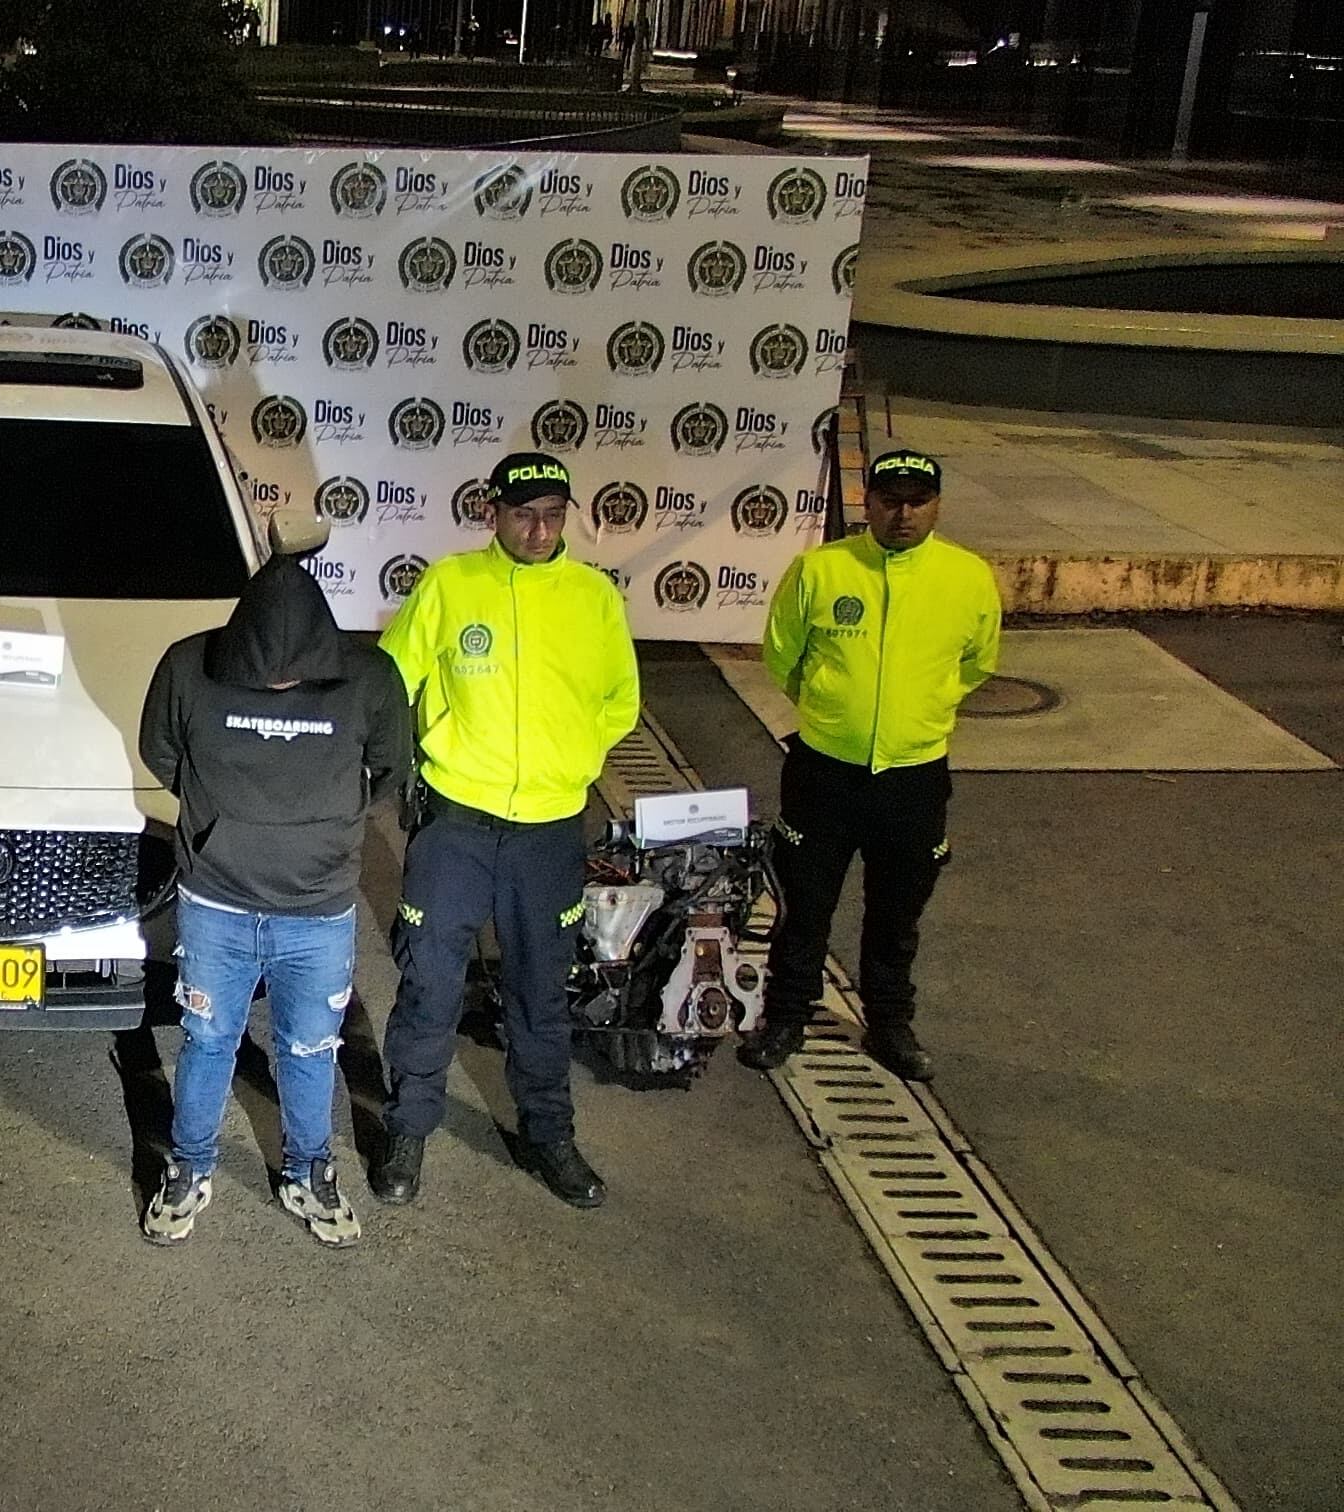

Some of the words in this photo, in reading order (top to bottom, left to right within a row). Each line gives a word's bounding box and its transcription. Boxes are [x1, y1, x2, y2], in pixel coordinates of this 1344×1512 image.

[18, 176, 24, 190] y
[115, 164, 154, 189] Dios
[160, 178, 166, 192] y
[255, 166, 294, 191] Dios
[300, 180, 306, 194] y
[540, 169, 580, 194] Dios
[586, 184, 592, 198] y
[688, 171, 728, 196] Dios
[734, 186, 742, 200] y
[115, 190, 166, 212] Patria
[255, 192, 306, 214] Patria
[539, 195, 591, 218] Patria
[687, 197, 740, 219] Patria
[44, 236, 83, 261] Dios
[88, 250, 94, 264] y
[184, 238, 223, 263] Dios
[228, 252, 234, 266] y
[464, 242, 503, 267] Dios
[510, 256, 516, 270] y
[611, 244, 651, 269] Dios
[656, 258, 664, 272] y
[754, 246, 794, 271] Dios
[800, 260, 808, 274] y
[44, 261, 94, 283] Patria
[184, 264, 234, 285] Patria
[463, 268, 514, 290] Patria
[610, 270, 661, 292] Patria
[753, 272, 804, 294] Patria
[248, 320, 286, 344] Dios
[292, 334, 298, 348] y
[387, 322, 426, 346] Dios
[432, 336, 438, 350] y
[673, 326, 712, 350] Dios
[718, 340, 724, 354] y
[247, 345, 297, 367] Patria
[386, 347, 437, 368] Patria
[672, 351, 723, 373] Patria
[315, 400, 353, 424] Dios
[358, 414, 366, 426] y
[453, 402, 492, 426] Dios
[496, 416, 504, 430] y
[596, 404, 635, 428] Dios
[640, 418, 648, 432] y
[736, 408, 775, 432] Dios
[780, 422, 788, 436] y
[314, 425, 364, 445] Patria
[452, 427, 502, 448] Patria
[595, 429, 645, 450] Patria
[734, 432, 785, 453] Patria
[875, 456, 935, 476] POLICÍA
[377, 481, 415, 504] Dios
[420, 494, 428, 508] y
[656, 486, 695, 510] Dios
[700, 500, 708, 514] y
[718, 566, 756, 589] Dios
[762, 580, 768, 592] y
[225, 715, 333, 735] SKATEBOARDING
